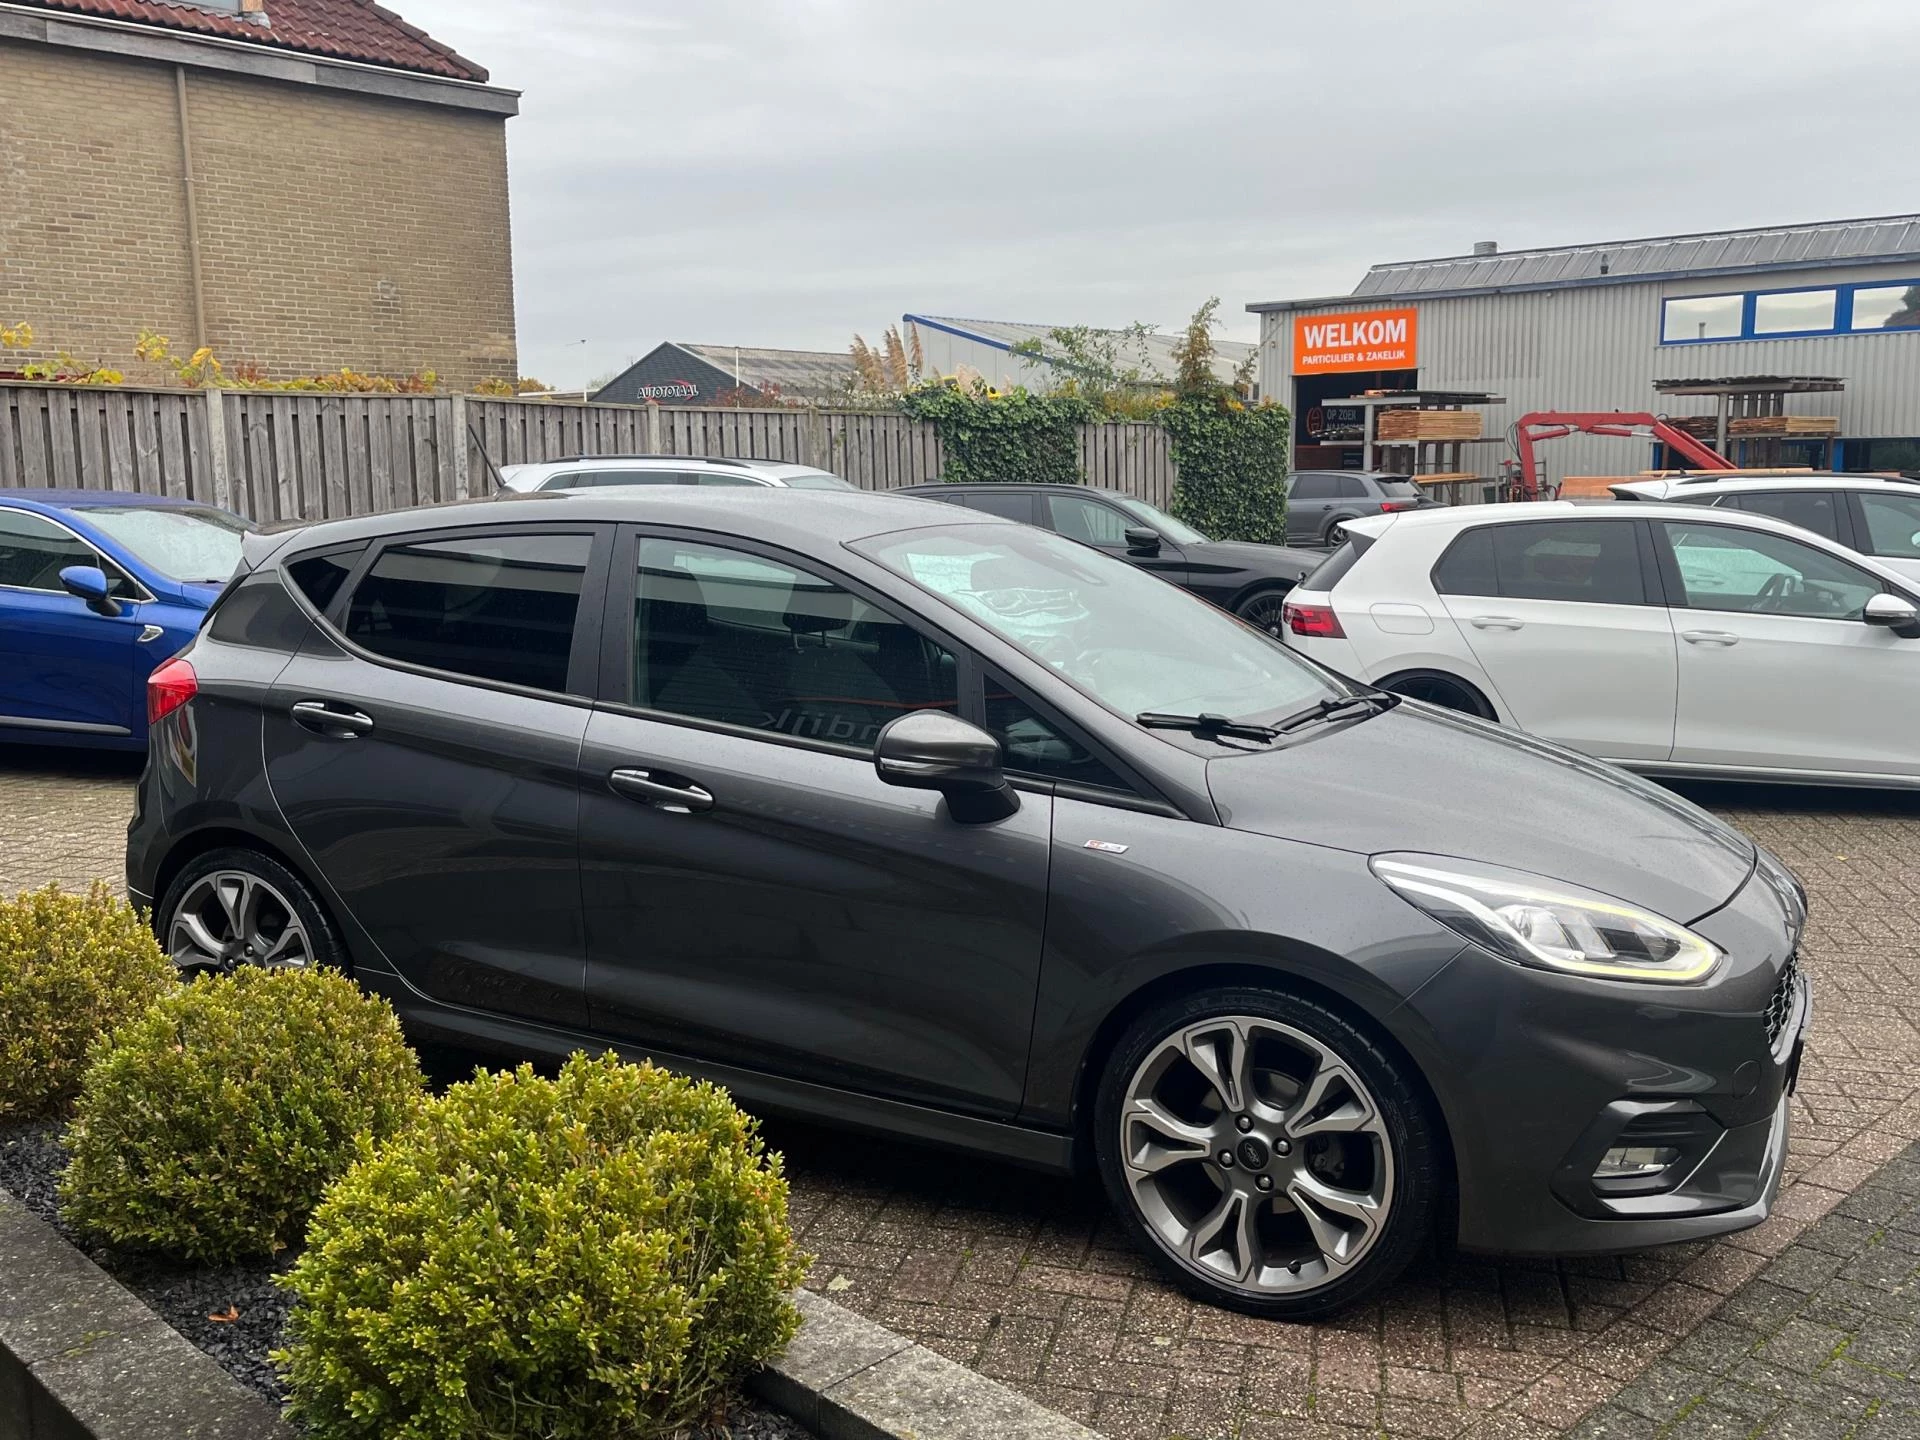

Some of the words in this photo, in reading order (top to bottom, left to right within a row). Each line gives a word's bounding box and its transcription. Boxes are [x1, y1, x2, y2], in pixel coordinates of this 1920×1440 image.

[1303, 318, 1407, 349] WELKOM
[1302, 352, 1355, 365] PARTICULIER
[1357, 352, 1364, 362] &
[1366, 349, 1406, 361] ZAKELIJK
[637, 384, 699, 399] AUTOTOTAAL
[1326, 408, 1337, 420] OP
[1338, 408, 1357, 421] ZOEK
